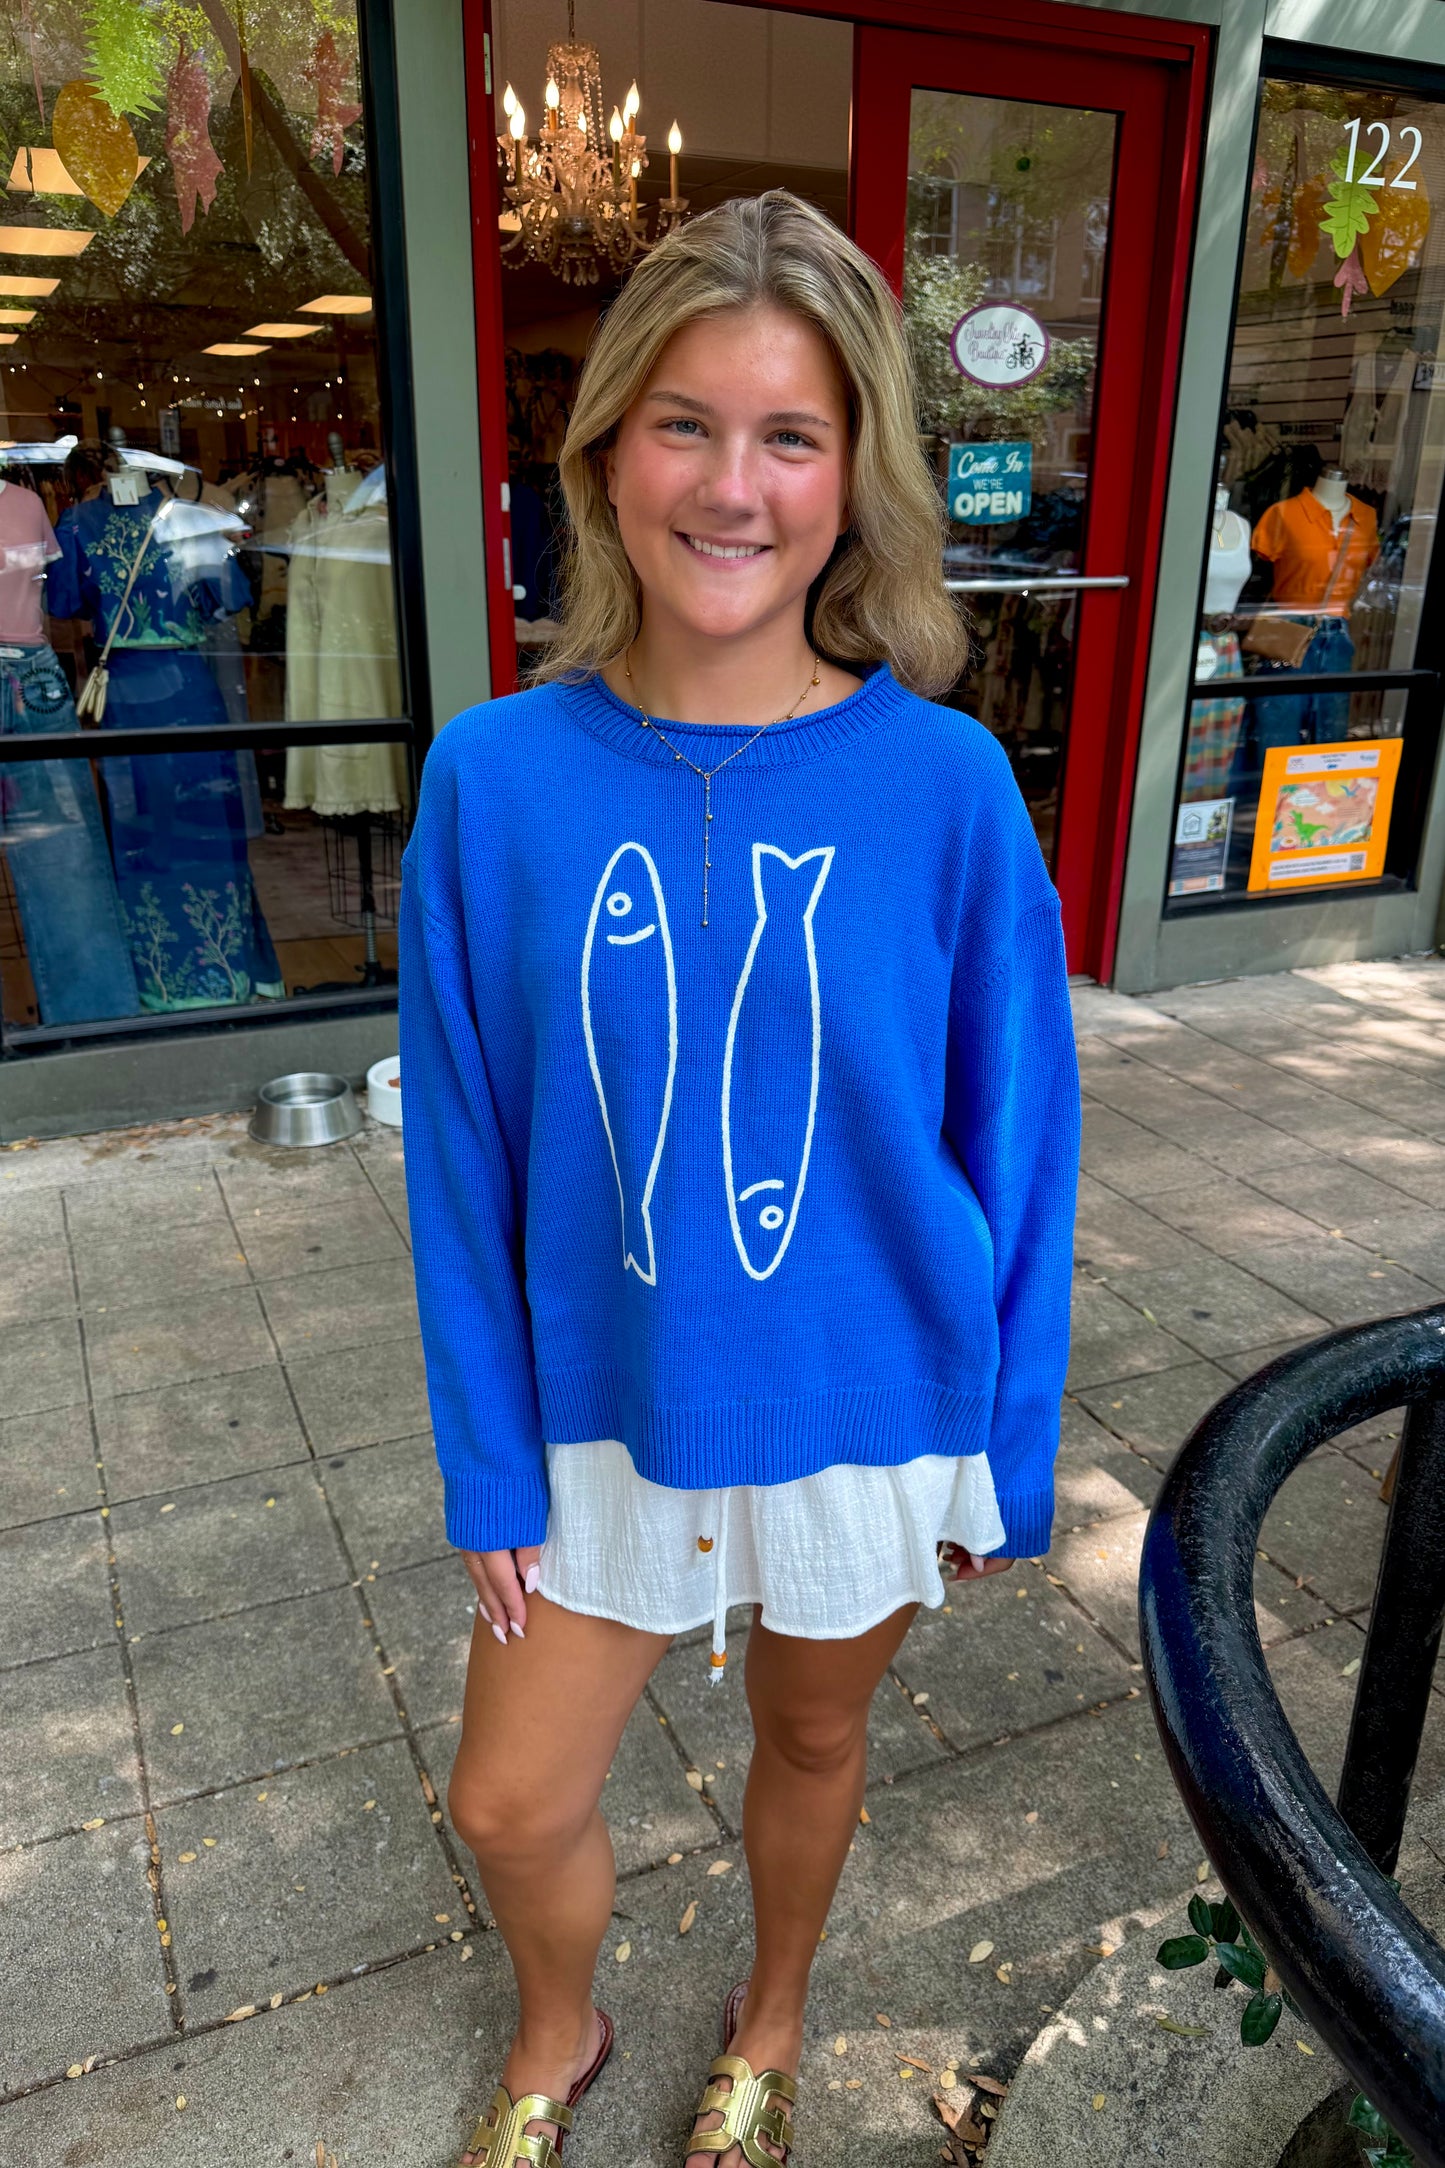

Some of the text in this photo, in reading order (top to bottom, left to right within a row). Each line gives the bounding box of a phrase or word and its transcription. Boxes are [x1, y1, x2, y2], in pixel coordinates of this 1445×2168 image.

[1343, 117, 1423, 190] 122
[957, 451, 1024, 479] Come In
[973, 478, 1004, 491] WE'RE
[954, 491, 1023, 517] OPEN
